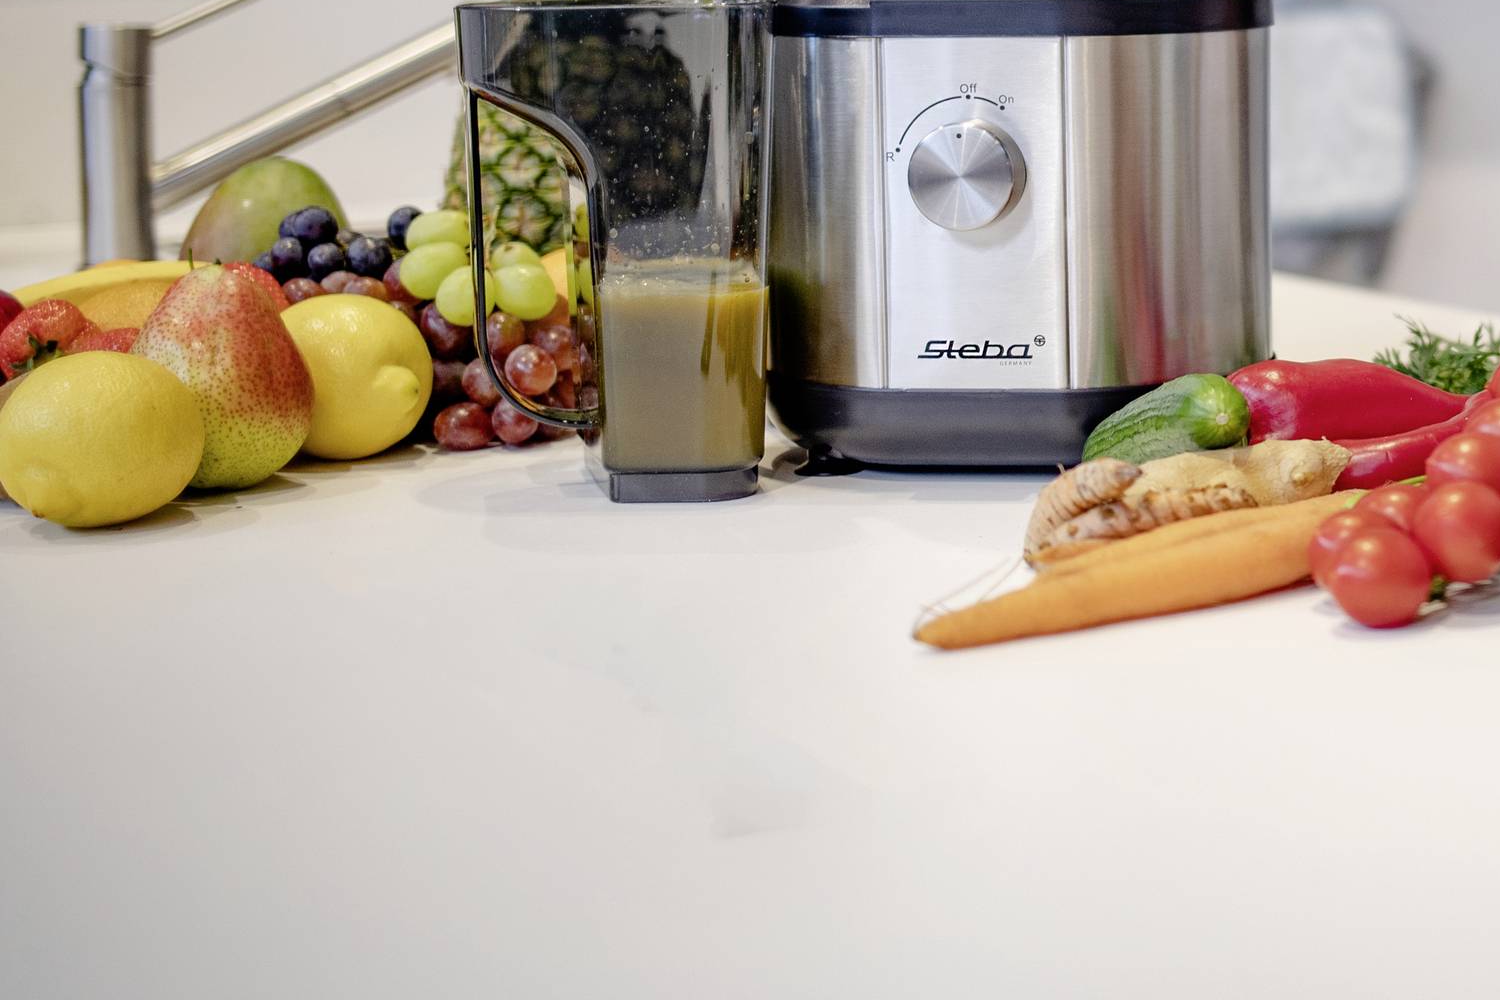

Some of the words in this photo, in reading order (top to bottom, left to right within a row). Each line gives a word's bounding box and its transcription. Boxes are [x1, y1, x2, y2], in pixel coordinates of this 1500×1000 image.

[959, 83, 977, 94] Off
[998, 94, 1014, 104] On
[886, 152, 895, 162] R
[917, 340, 1033, 359] Steba
